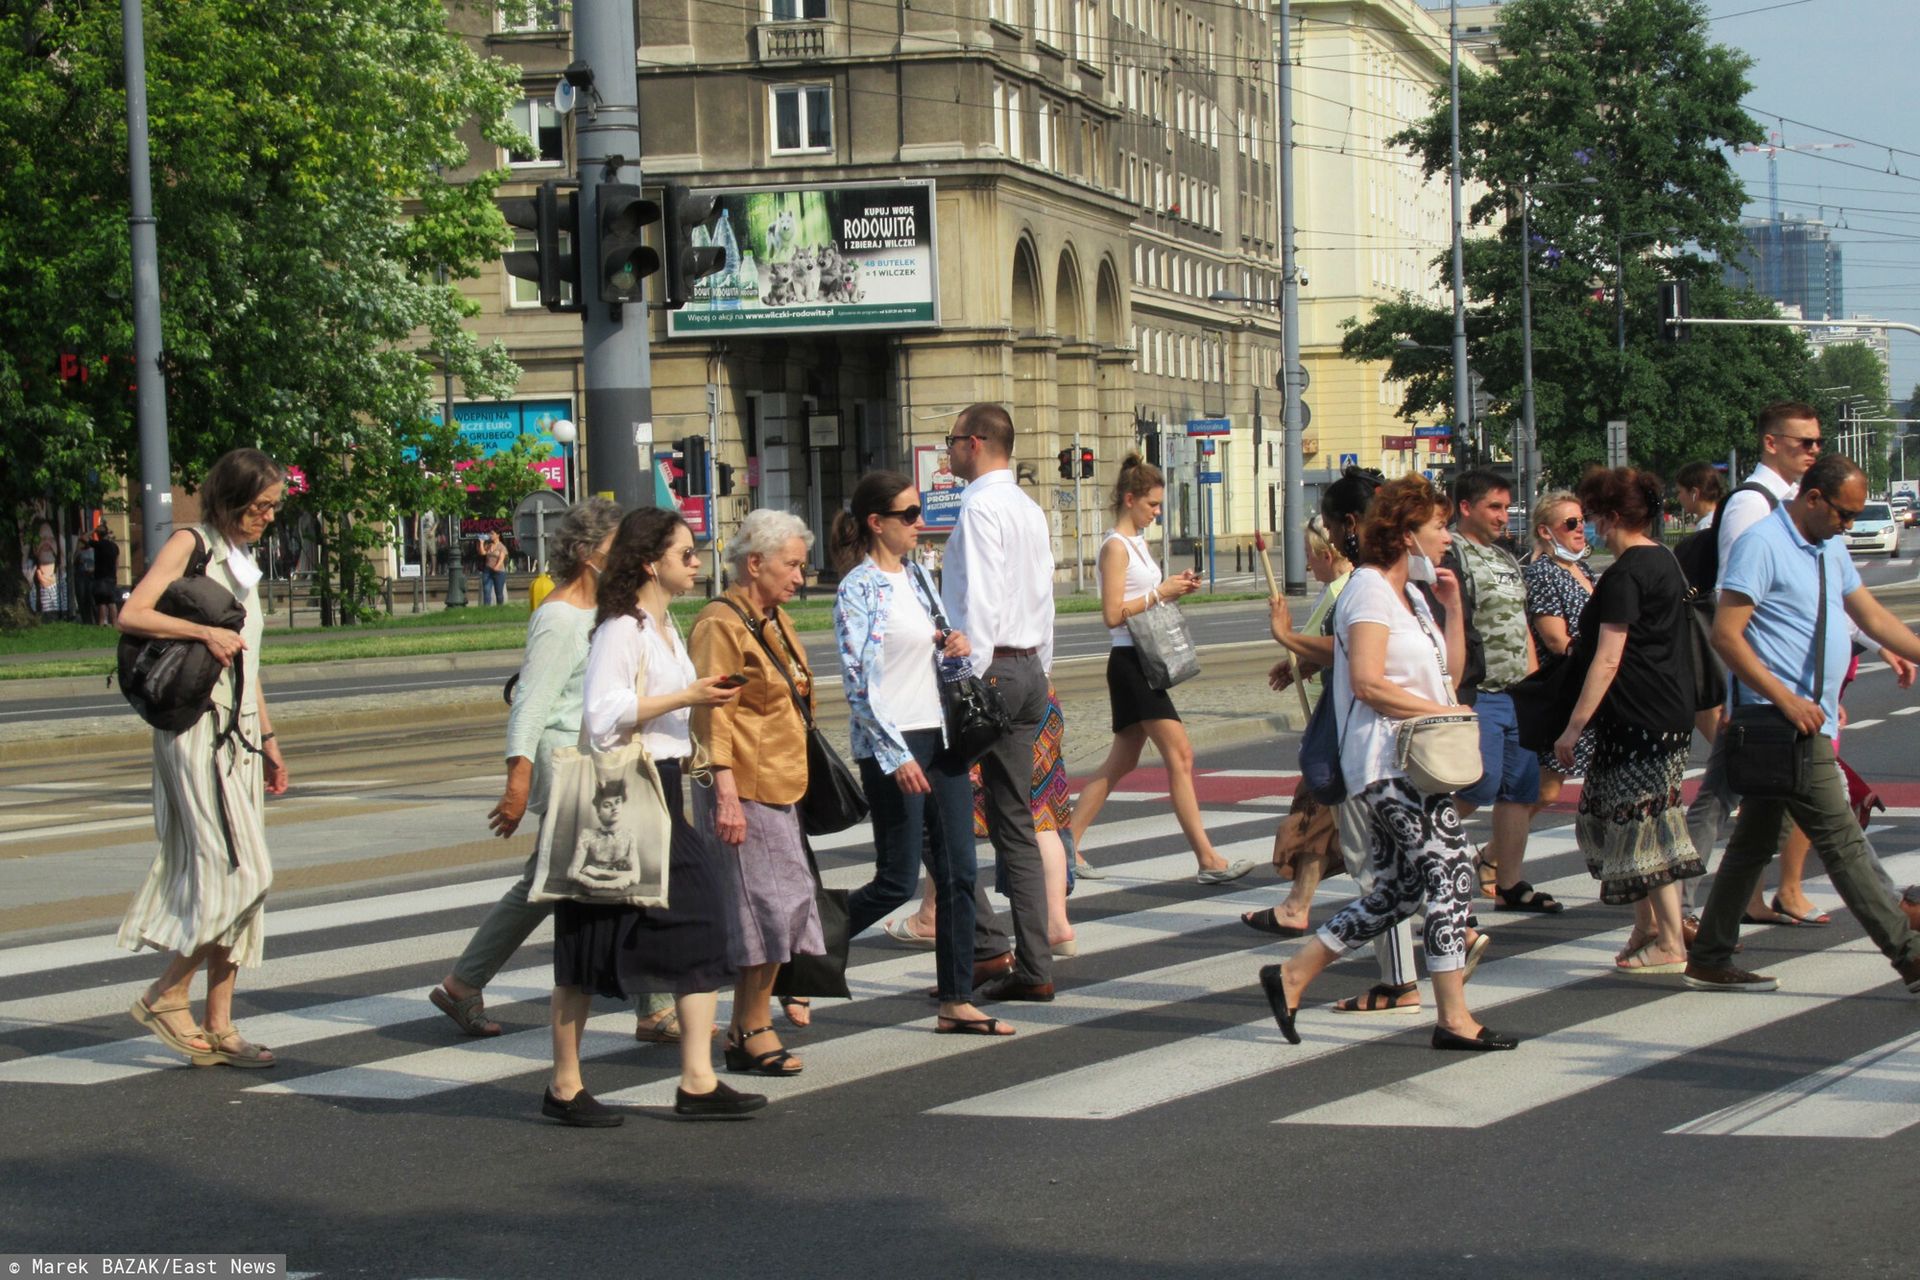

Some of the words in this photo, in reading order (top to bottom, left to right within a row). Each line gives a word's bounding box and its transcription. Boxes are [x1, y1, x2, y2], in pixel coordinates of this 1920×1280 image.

[864, 207, 889, 216] KUPUJ
[892, 206, 914, 216] WODĘ
[844, 216, 915, 239] RODOWITA
[844, 241, 848, 250] I
[850, 240, 882, 249] ZBIERAJ
[884, 238, 916, 248] WILCZKI
[877, 259, 915, 267] BUTELEK
[879, 269, 916, 277] WILCZEK
[687, 314, 710, 322] Więcej
[718, 314, 733, 322] akcji
[745, 309, 834, 320] www.wilczki-rodowita.pl
[496, 411, 510, 420] NA
[460, 422, 484, 431] ECZE
[486, 421, 513, 430] EURO
[469, 431, 515, 440] GRUBEGO
[927, 493, 961, 503] PROSTA
